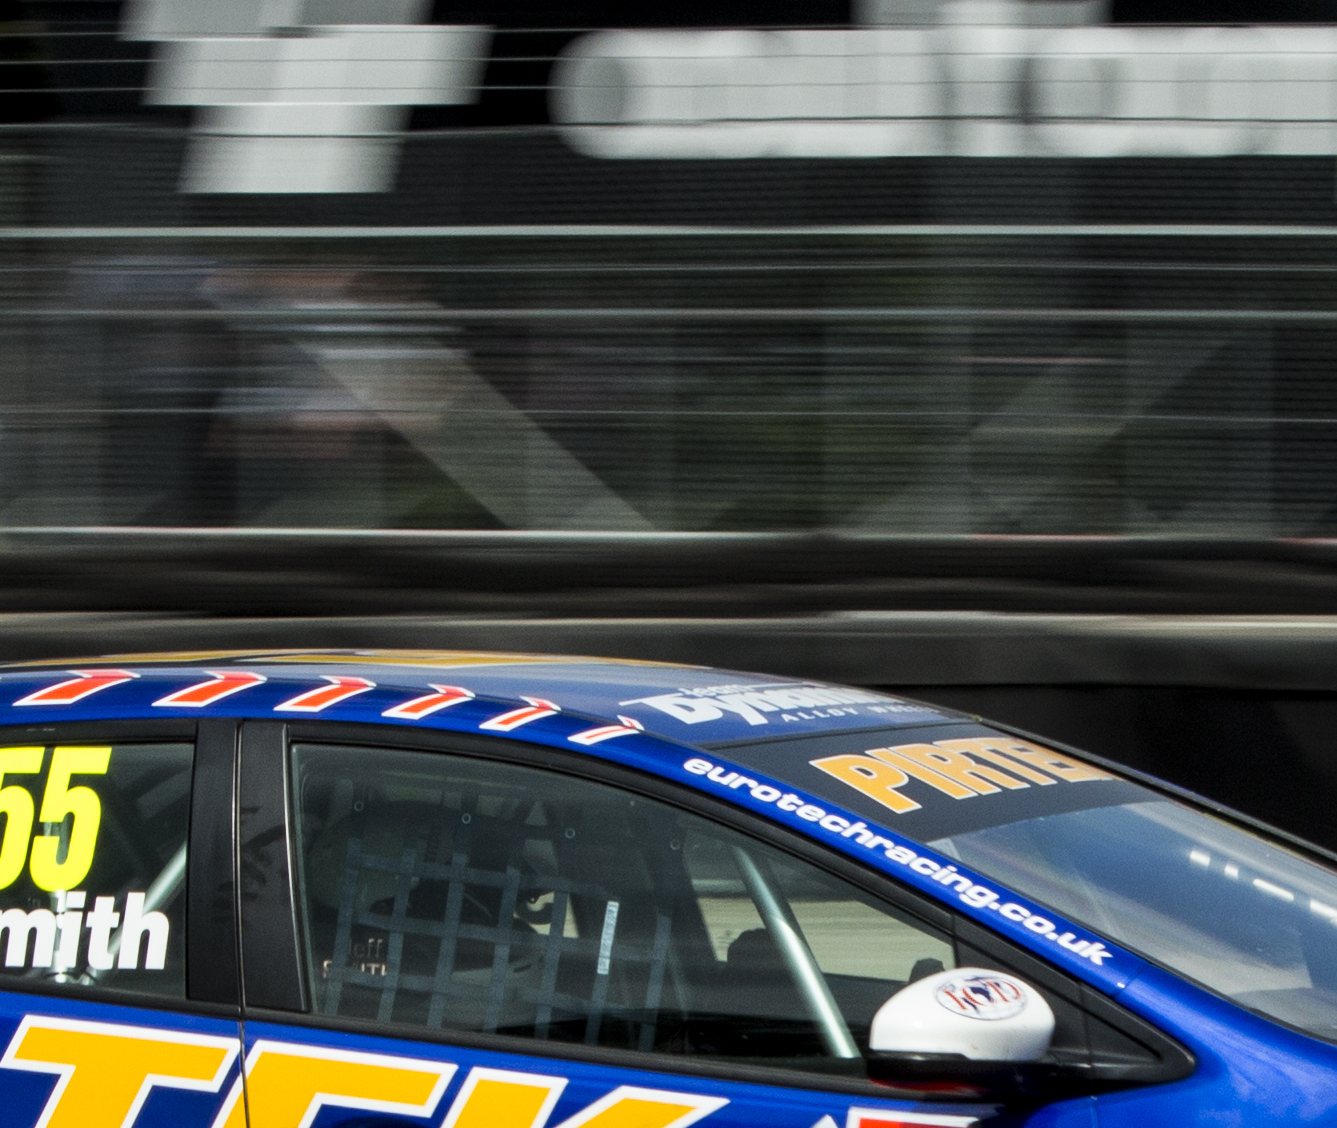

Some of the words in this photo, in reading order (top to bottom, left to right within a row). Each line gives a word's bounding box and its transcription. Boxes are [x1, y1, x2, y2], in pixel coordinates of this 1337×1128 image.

[781, 707, 859, 723] ALLOY
[809, 737, 1116, 814] PIRTE
[683, 757, 1113, 966] eurotechracing.co.uk
